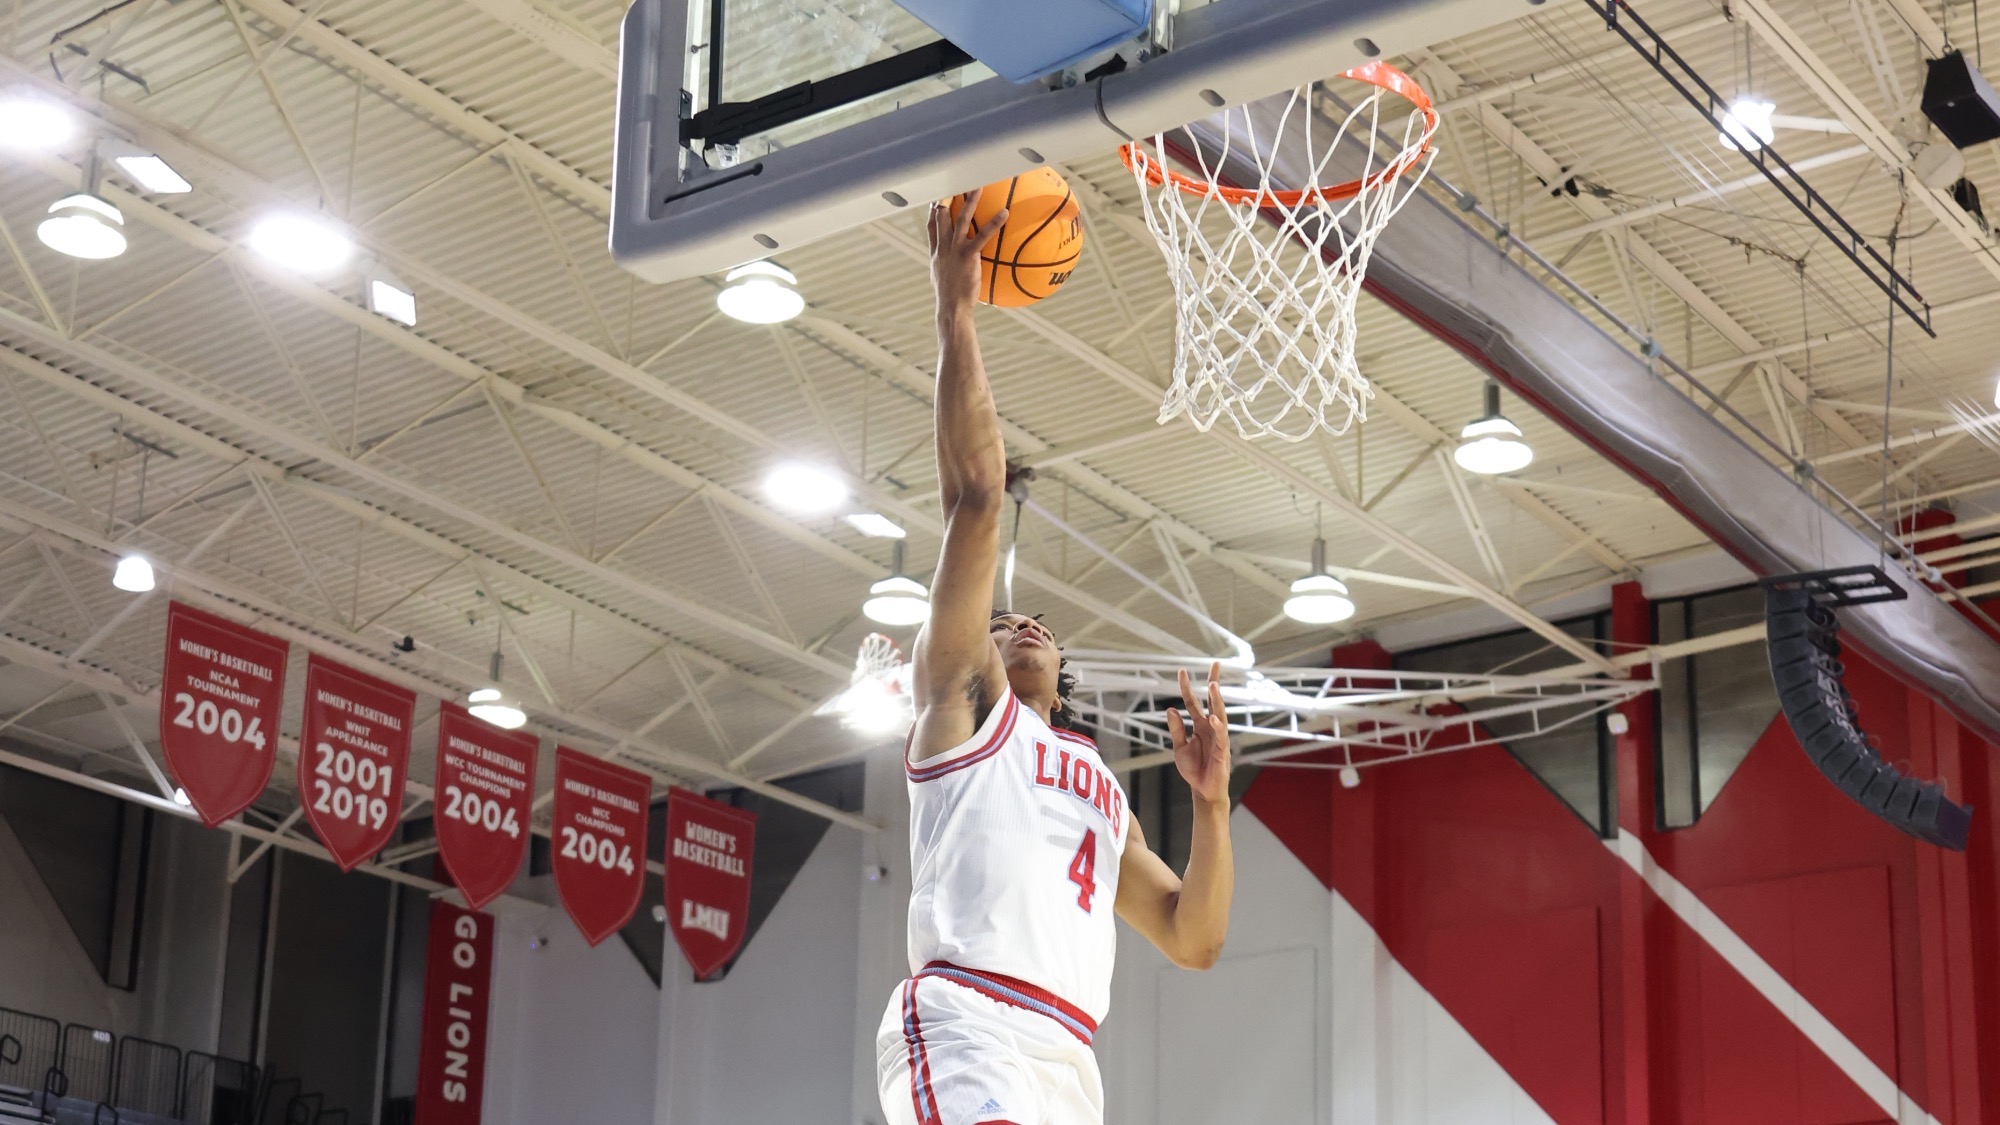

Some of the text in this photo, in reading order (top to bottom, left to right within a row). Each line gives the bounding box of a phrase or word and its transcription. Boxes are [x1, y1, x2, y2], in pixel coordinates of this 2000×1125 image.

[180, 638, 273, 682] WOMEN'S BASKETBALL
[209, 670, 240, 689] NCAA
[187, 675, 261, 709] TOURNAMENT
[318, 689, 402, 732] WOMEN'S BASKETBALL
[173, 692, 267, 752] 2004
[325, 726, 389, 758] APPEARANCE
[345, 720, 371, 737] WNIT
[314, 742, 393, 798] 2001
[444, 753, 527, 792] WCC TOURNAMENT
[449, 735, 526, 775] WOMEN'S BASKETBALL
[313, 779, 388, 831] 2019
[459, 771, 511, 799] CHAMPIONS
[564, 778, 640, 814] WOMEN'S BASKETBALL
[1033, 738, 1123, 843] LIONS
[444, 785, 520, 839] 2004
[575, 812, 626, 838] CHAMPIONS
[592, 805, 611, 820] WCC
[560, 826, 635, 877] 2004
[673, 837, 745, 878] BASKETBALL
[685, 820, 737, 854] WOMEN'S
[1067, 826, 1097, 914] 4
[682, 898, 730, 942] LMU
[442, 915, 478, 1103] GO LIONS
